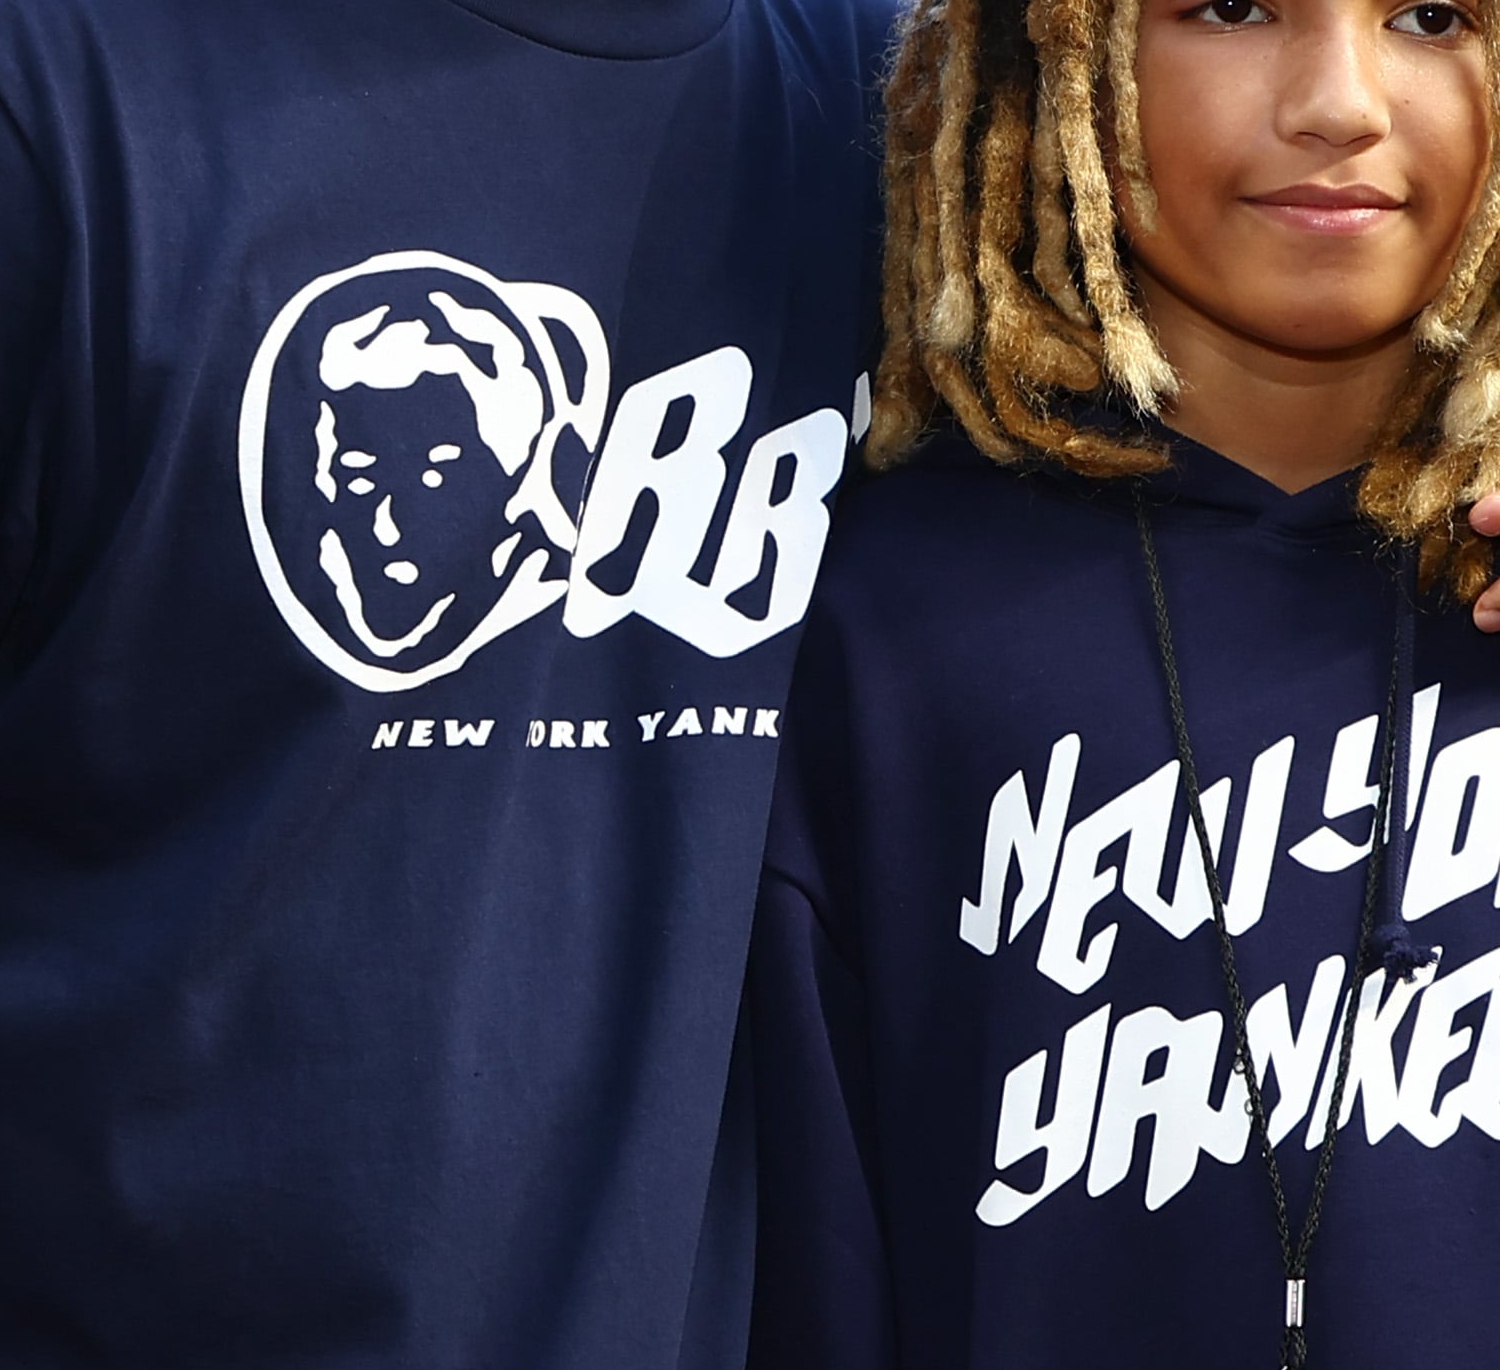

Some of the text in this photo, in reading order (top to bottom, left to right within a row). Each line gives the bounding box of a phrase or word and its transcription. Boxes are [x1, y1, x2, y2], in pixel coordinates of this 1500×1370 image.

[371, 719, 495, 749] NEW
[526, 719, 610, 748] ORK
[960, 732, 1295, 994] NEW
